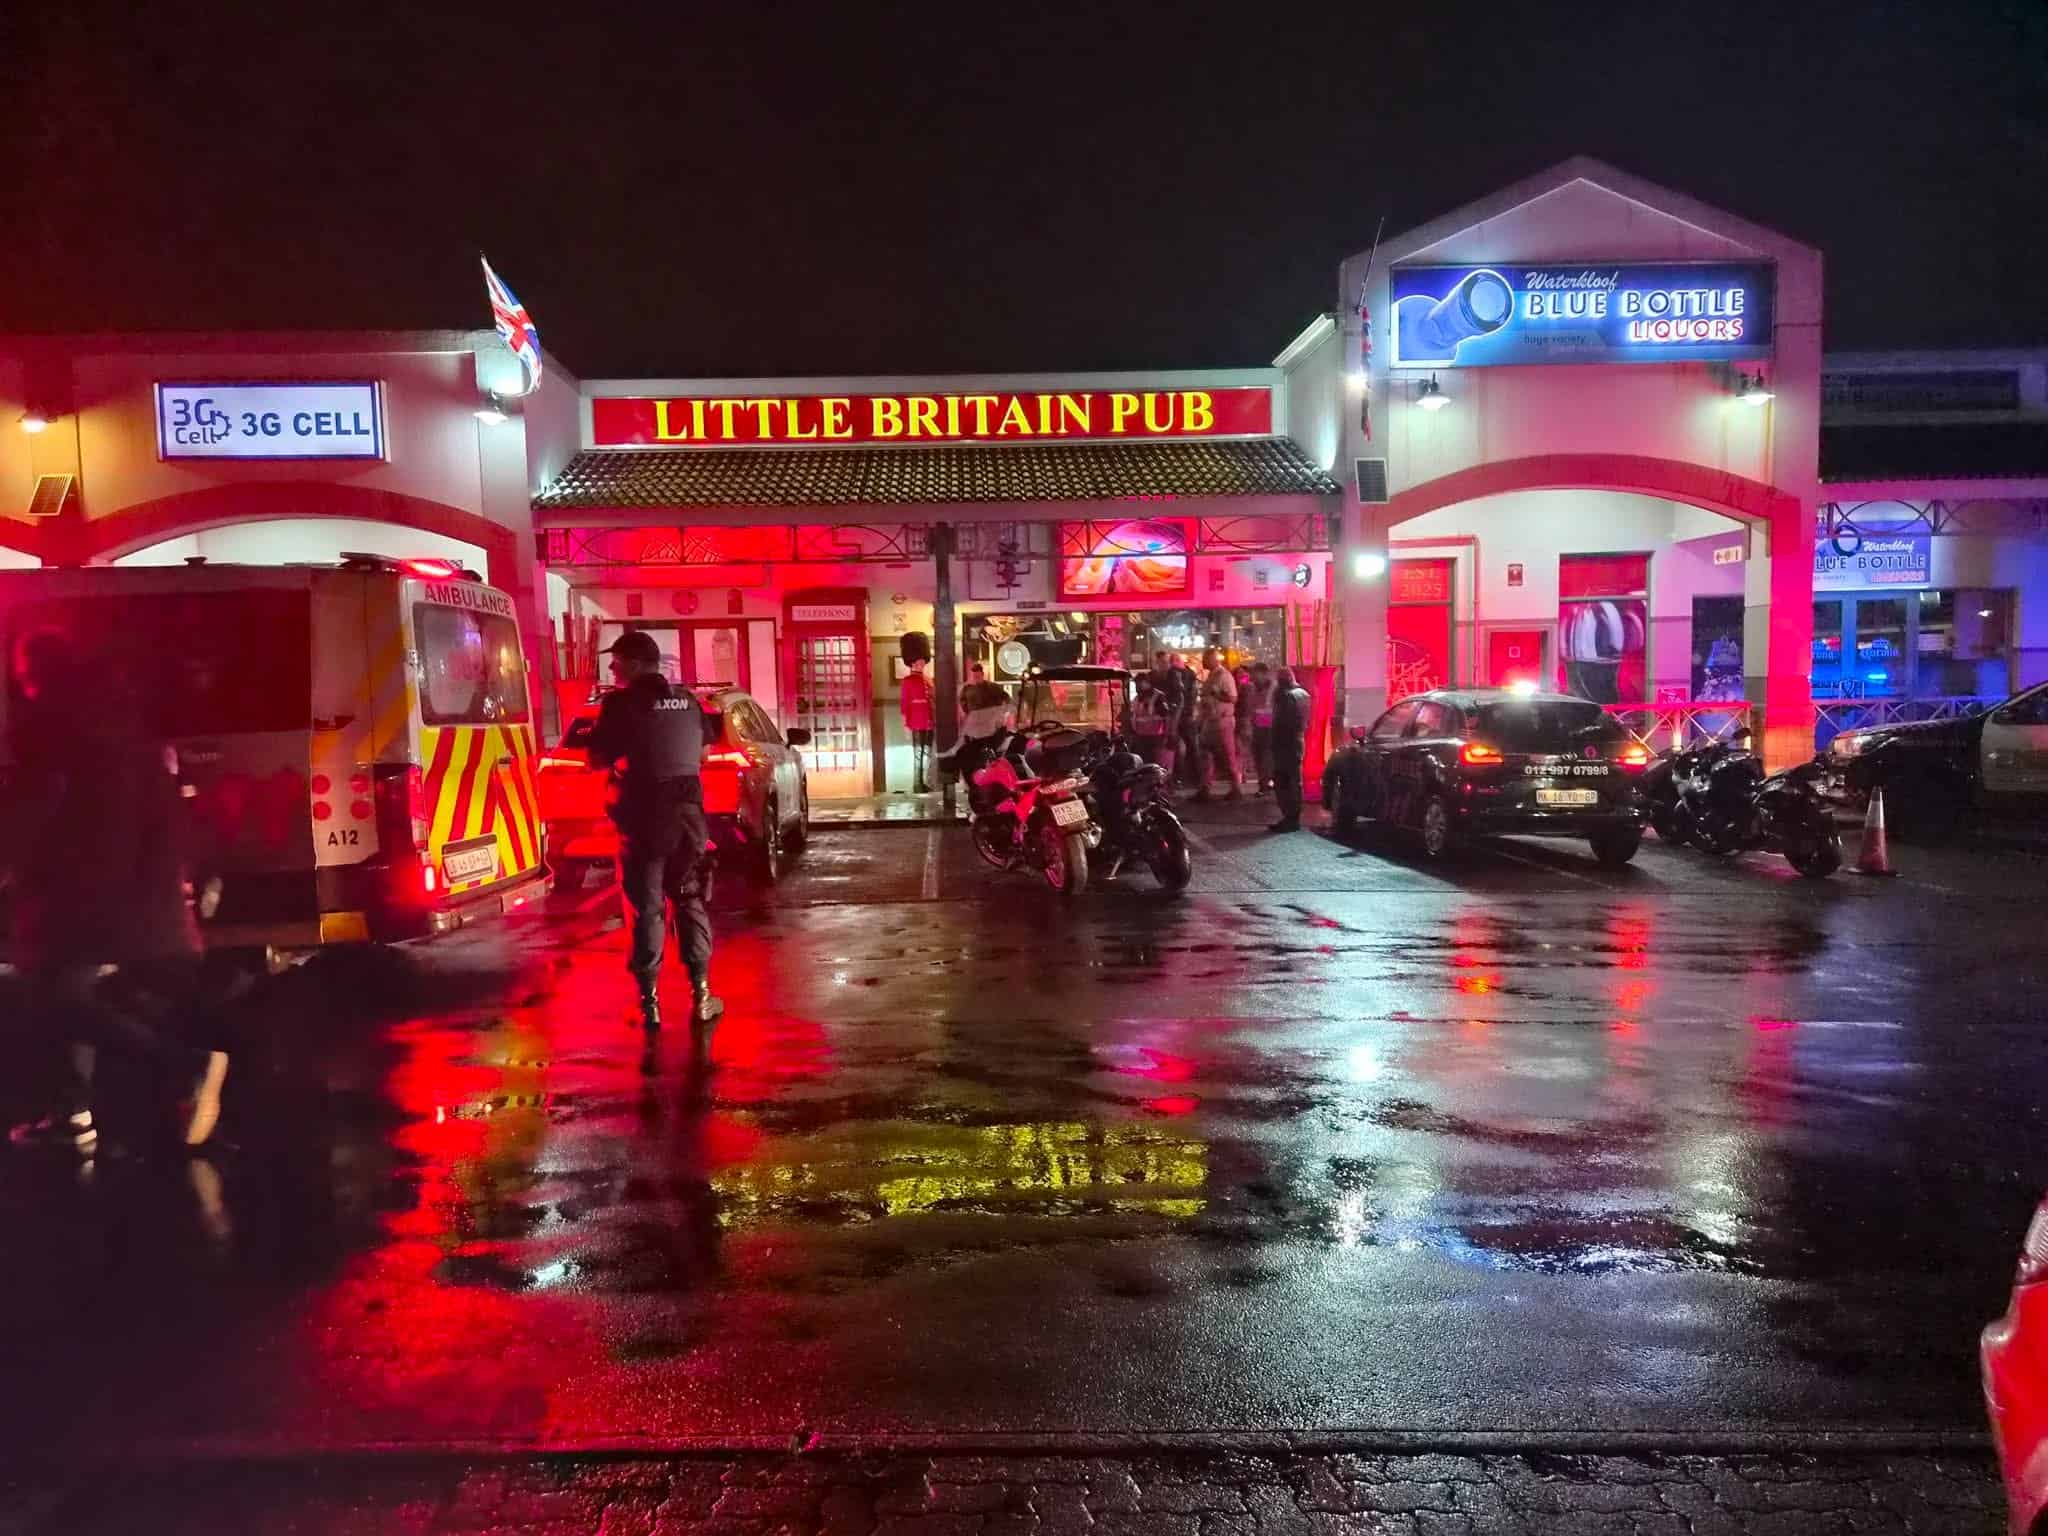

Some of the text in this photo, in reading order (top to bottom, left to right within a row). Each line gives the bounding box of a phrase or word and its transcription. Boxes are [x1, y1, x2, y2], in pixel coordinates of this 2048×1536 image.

[1524, 271, 1619, 293] Waterkloof
[1527, 288, 1744, 317] BLUE BOTTLE
[1632, 318, 1744, 341] LIQUORS
[172, 398, 216, 427] 3G
[653, 391, 1215, 440] LITTLE BRITAIN PUB
[241, 412, 370, 436] 3G CELL
[175, 427, 217, 445] Cell
[1816, 553, 1926, 570] LUE BOTTLE
[425, 583, 511, 615] AMBULANCE
[654, 699, 688, 710] AXON
[1524, 765, 1546, 775] 012
[1550, 766, 1570, 776] 997
[328, 830, 359, 847] A12
